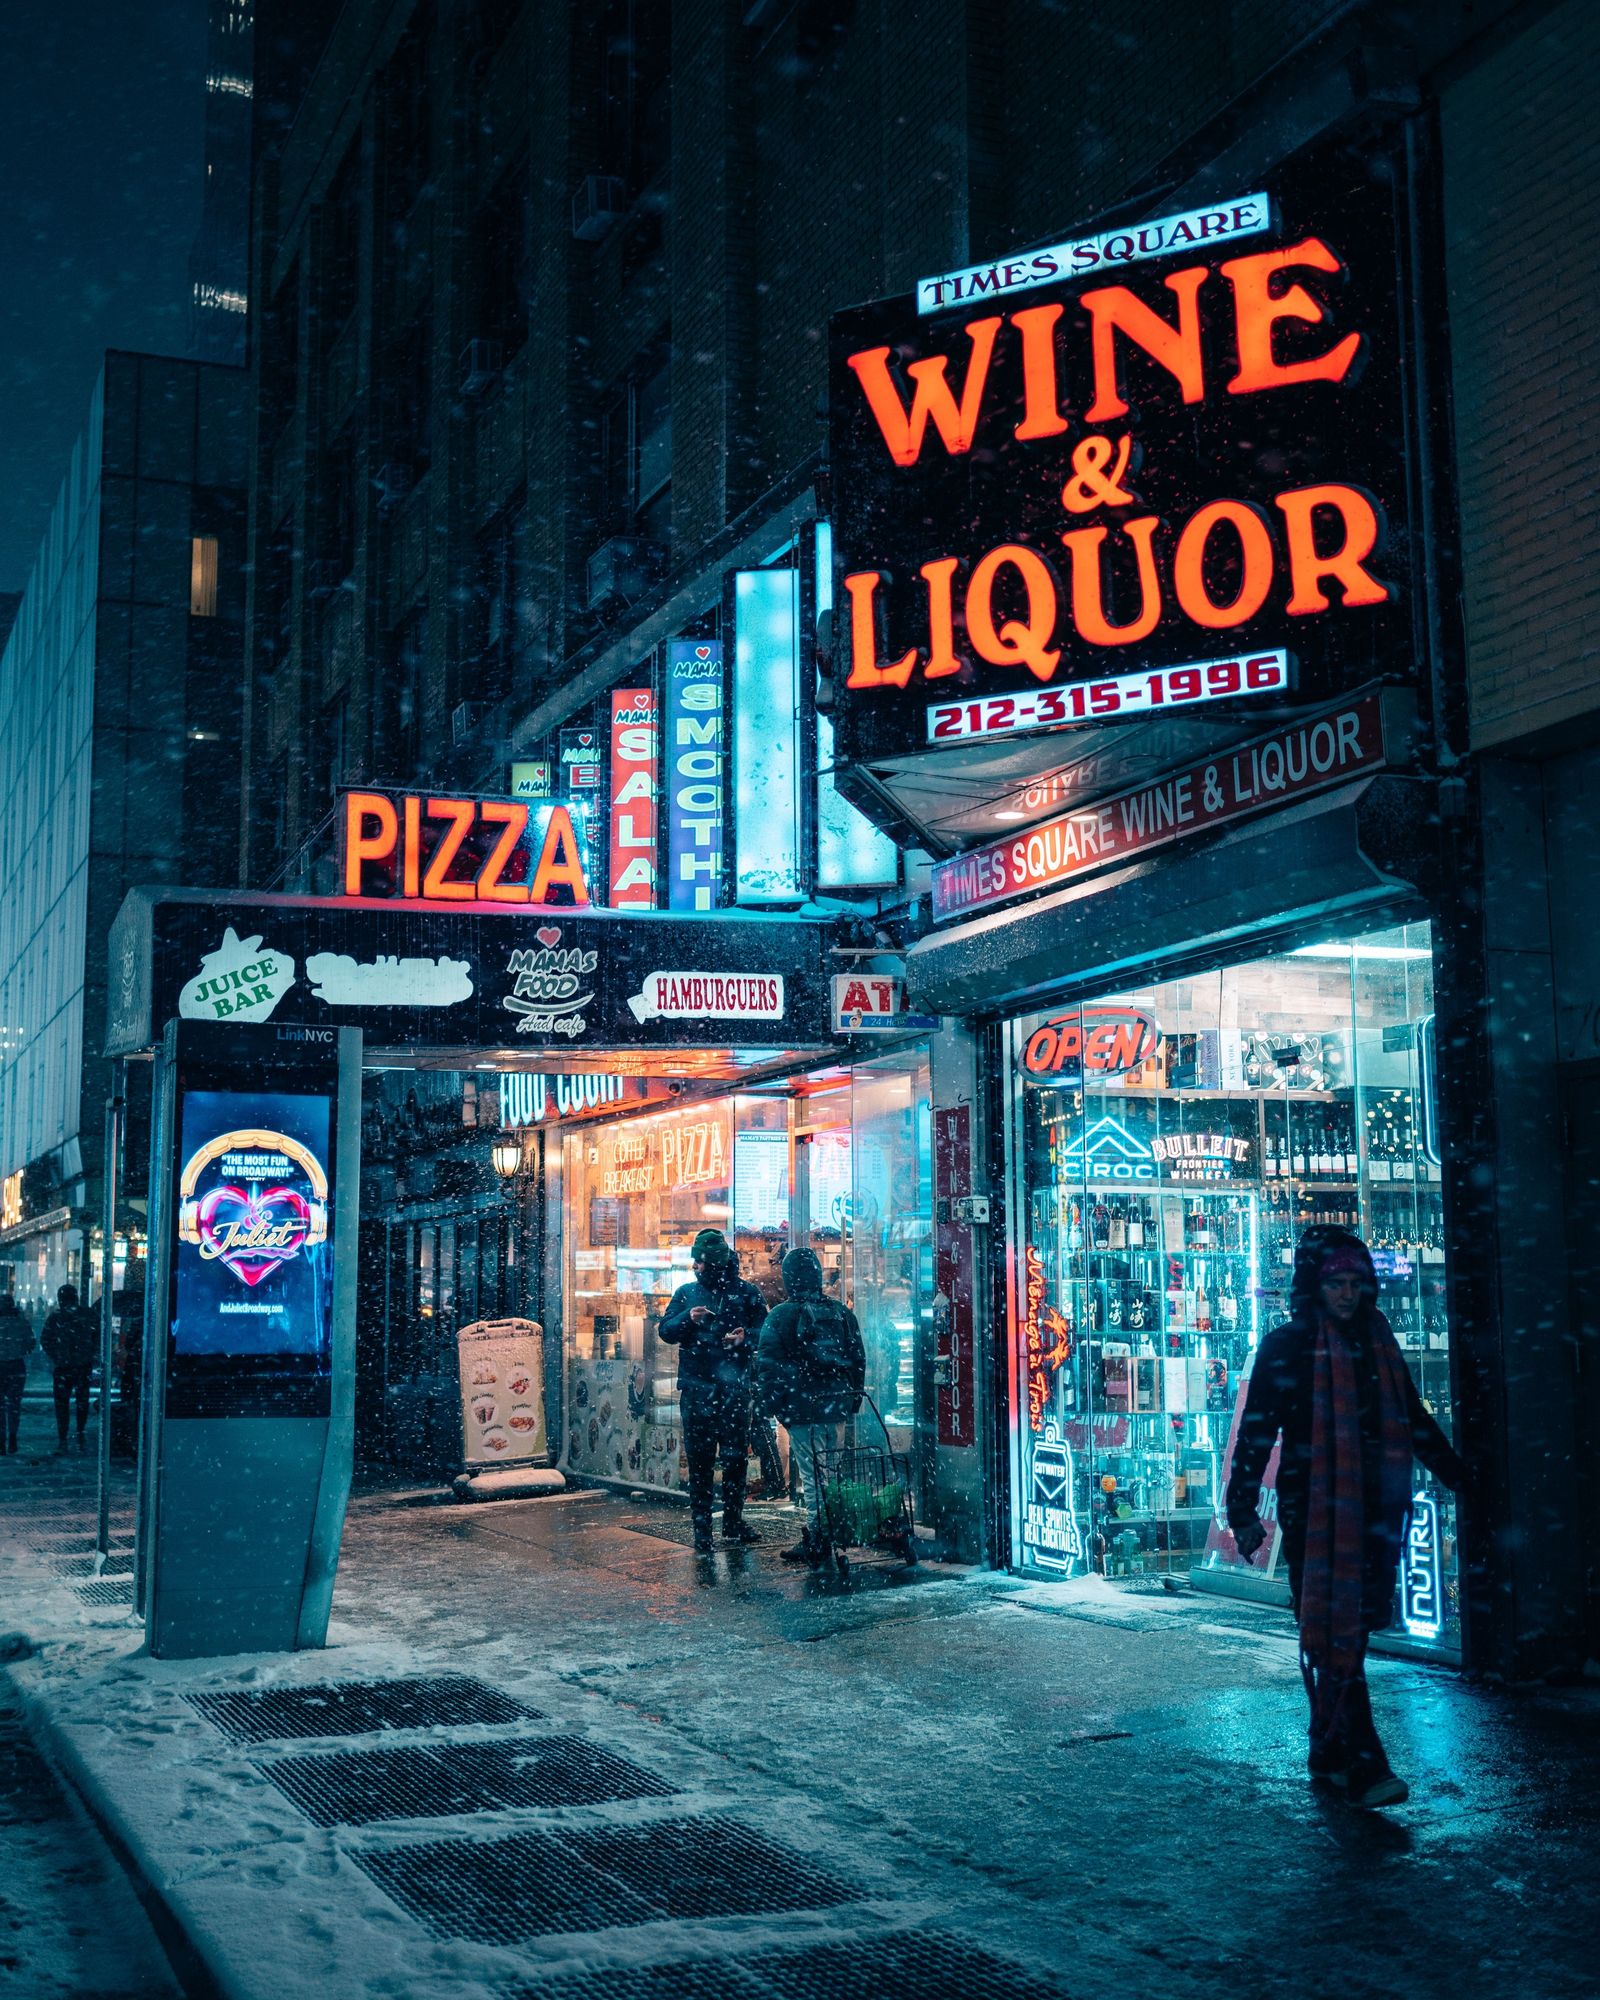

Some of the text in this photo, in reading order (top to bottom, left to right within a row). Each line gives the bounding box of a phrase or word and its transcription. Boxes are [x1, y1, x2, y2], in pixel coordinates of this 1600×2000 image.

[925, 202, 1263, 306] TIMES SQUARE
[847, 236, 1361, 468] WINE
[1061, 434, 1134, 515] &
[844, 483, 1389, 690] LIQUOR
[933, 653, 1281, 739] 212-315-1996
[940, 711, 1364, 909] TIMES SQUARE WINE & LIQUOR
[345, 791, 590, 906] PIZZA
[194, 957, 279, 1003] JUICE
[513, 972, 580, 999] FOOD
[656, 974, 778, 1013] HAMBURGUERS
[212, 983, 275, 1019] BAR
[277, 1028, 334, 1043] LinkNYC
[516, 1013, 587, 1038] And cafe
[871, 1018, 882, 1026] 24
[1026, 1023, 1145, 1072] OPEN
[244, 1155, 269, 1166] MOST
[271, 1156, 288, 1166] FUN
[613, 1137, 645, 1164] COFFEE
[662, 1122, 726, 1187] PIZZA
[1176, 1159, 1225, 1169] FRONTIER
[221, 1166, 236, 1176] ON
[603, 1166, 655, 1195] BREAKFAST
[199, 1220, 307, 1260] Juliet
[950, 1280, 961, 1437] LIQUOR
[1029, 1372, 1049, 1433] Trois
[1034, 1461, 1065, 1478] CUTWATER
[1024, 1522, 1041, 1545] REAL
[1028, 1503, 1043, 1527] REAL
